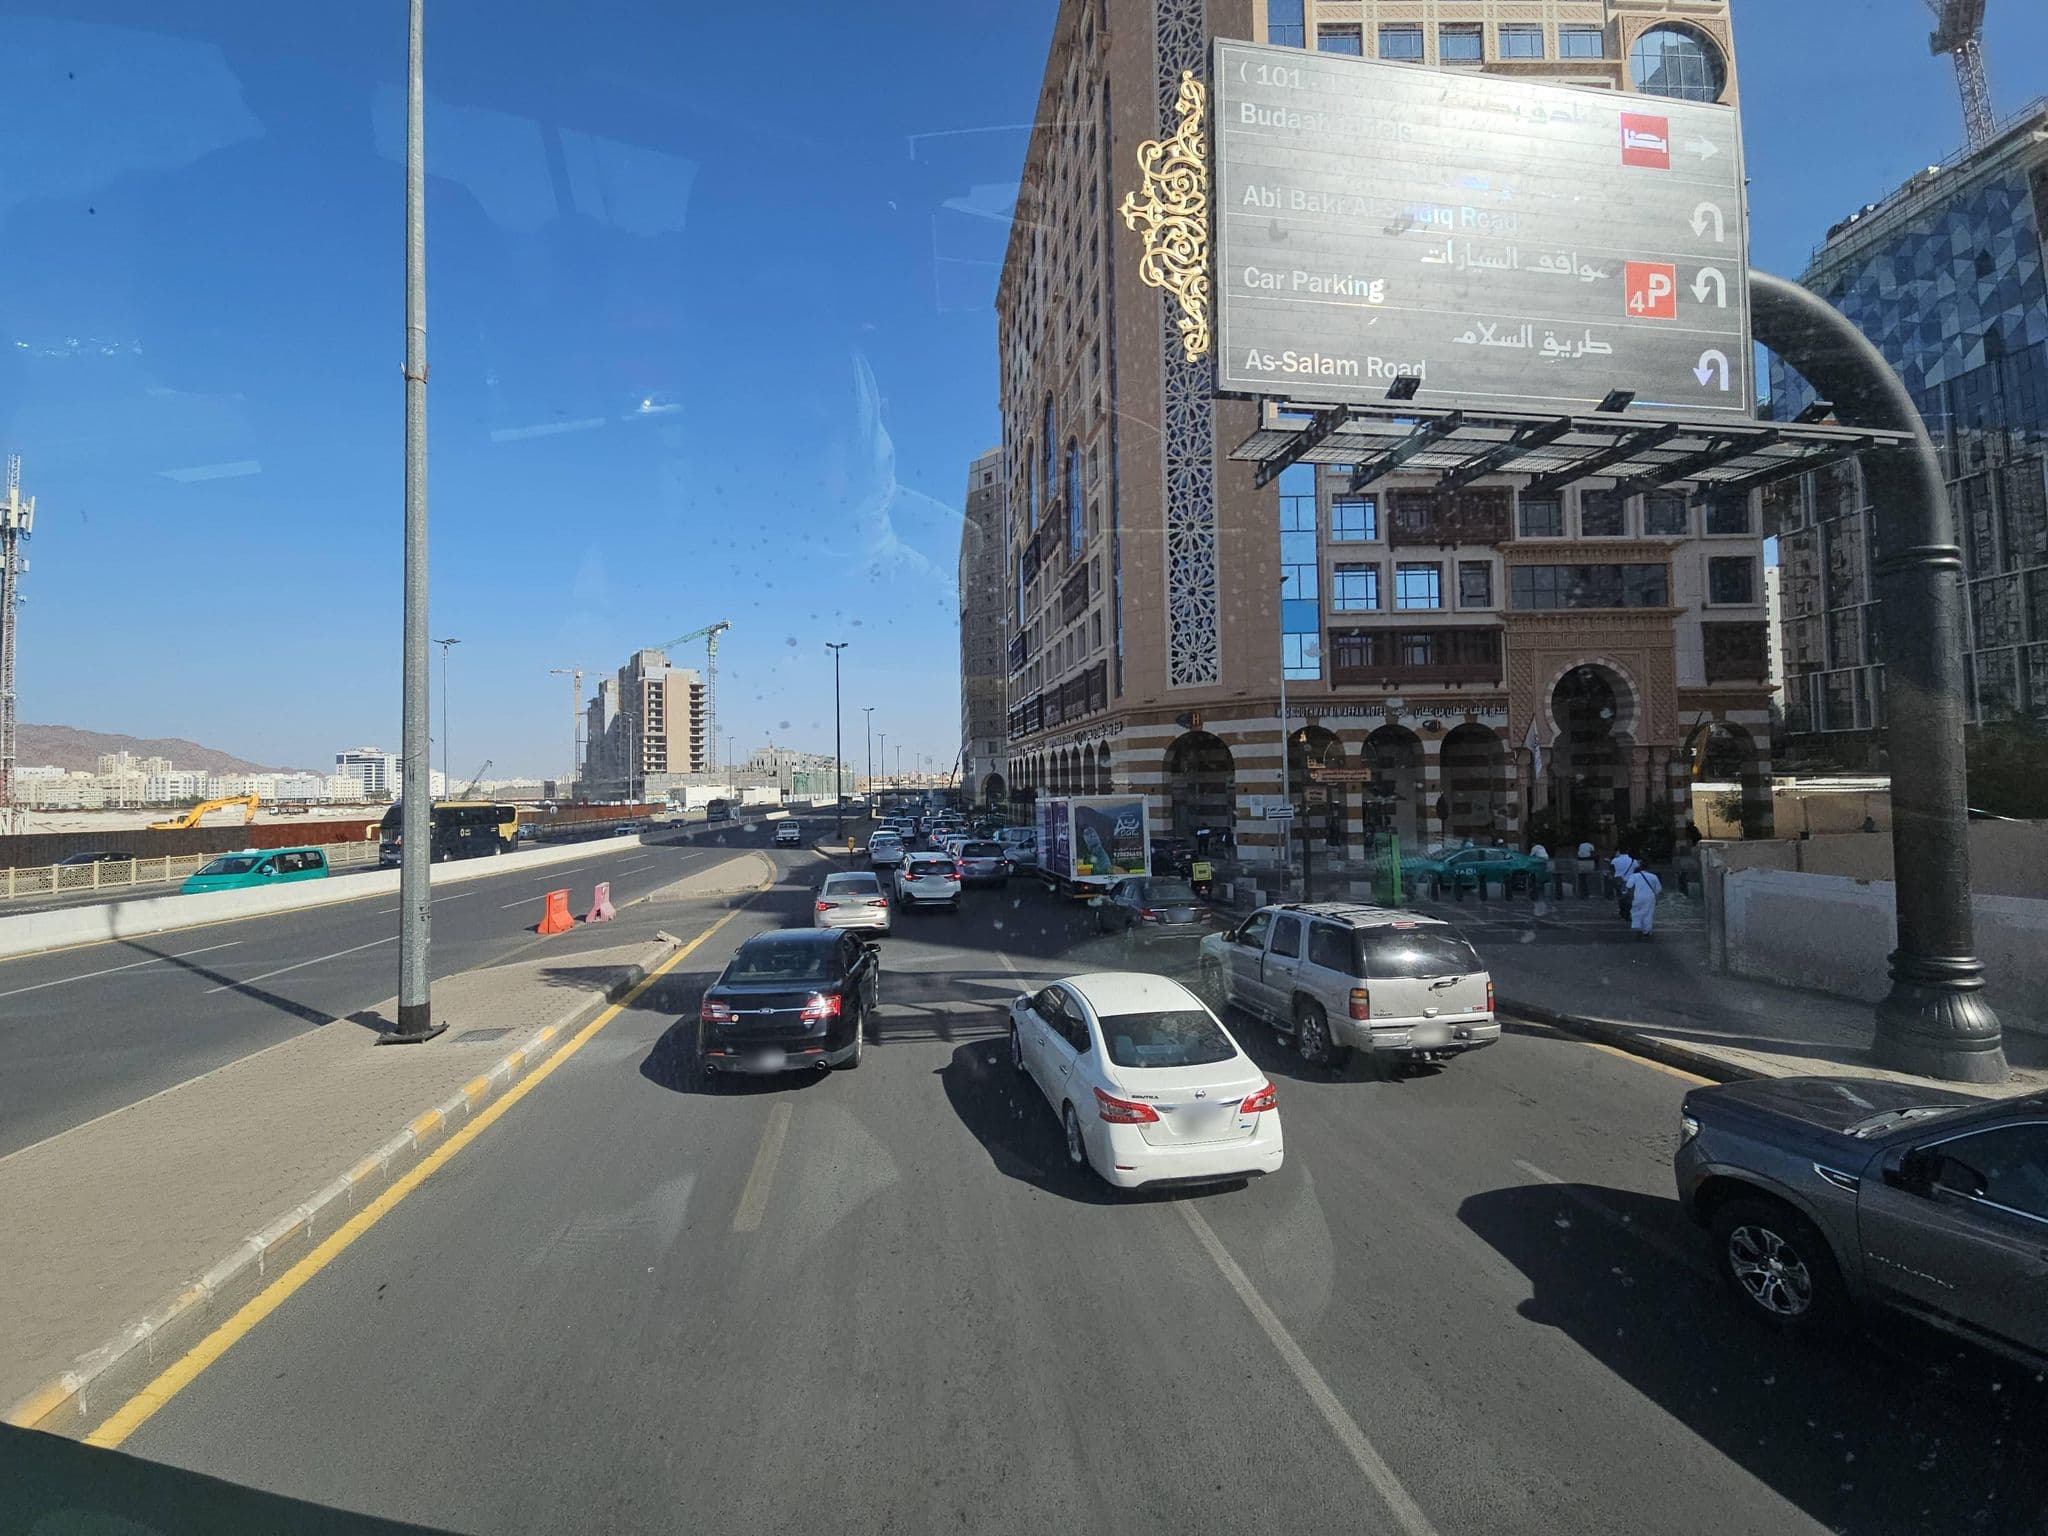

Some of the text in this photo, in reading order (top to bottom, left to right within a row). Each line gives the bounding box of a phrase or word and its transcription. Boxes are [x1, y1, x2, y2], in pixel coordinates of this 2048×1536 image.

[1243, 184, 1518, 231] Abi Bakr Al-Sdiq Road
[1420, 239, 1519, 273] السيارات
[1243, 266, 1384, 303] Car Parking
[1452, 321, 1613, 359] طريق السلام
[1245, 348, 1426, 381] As-Salam Road
